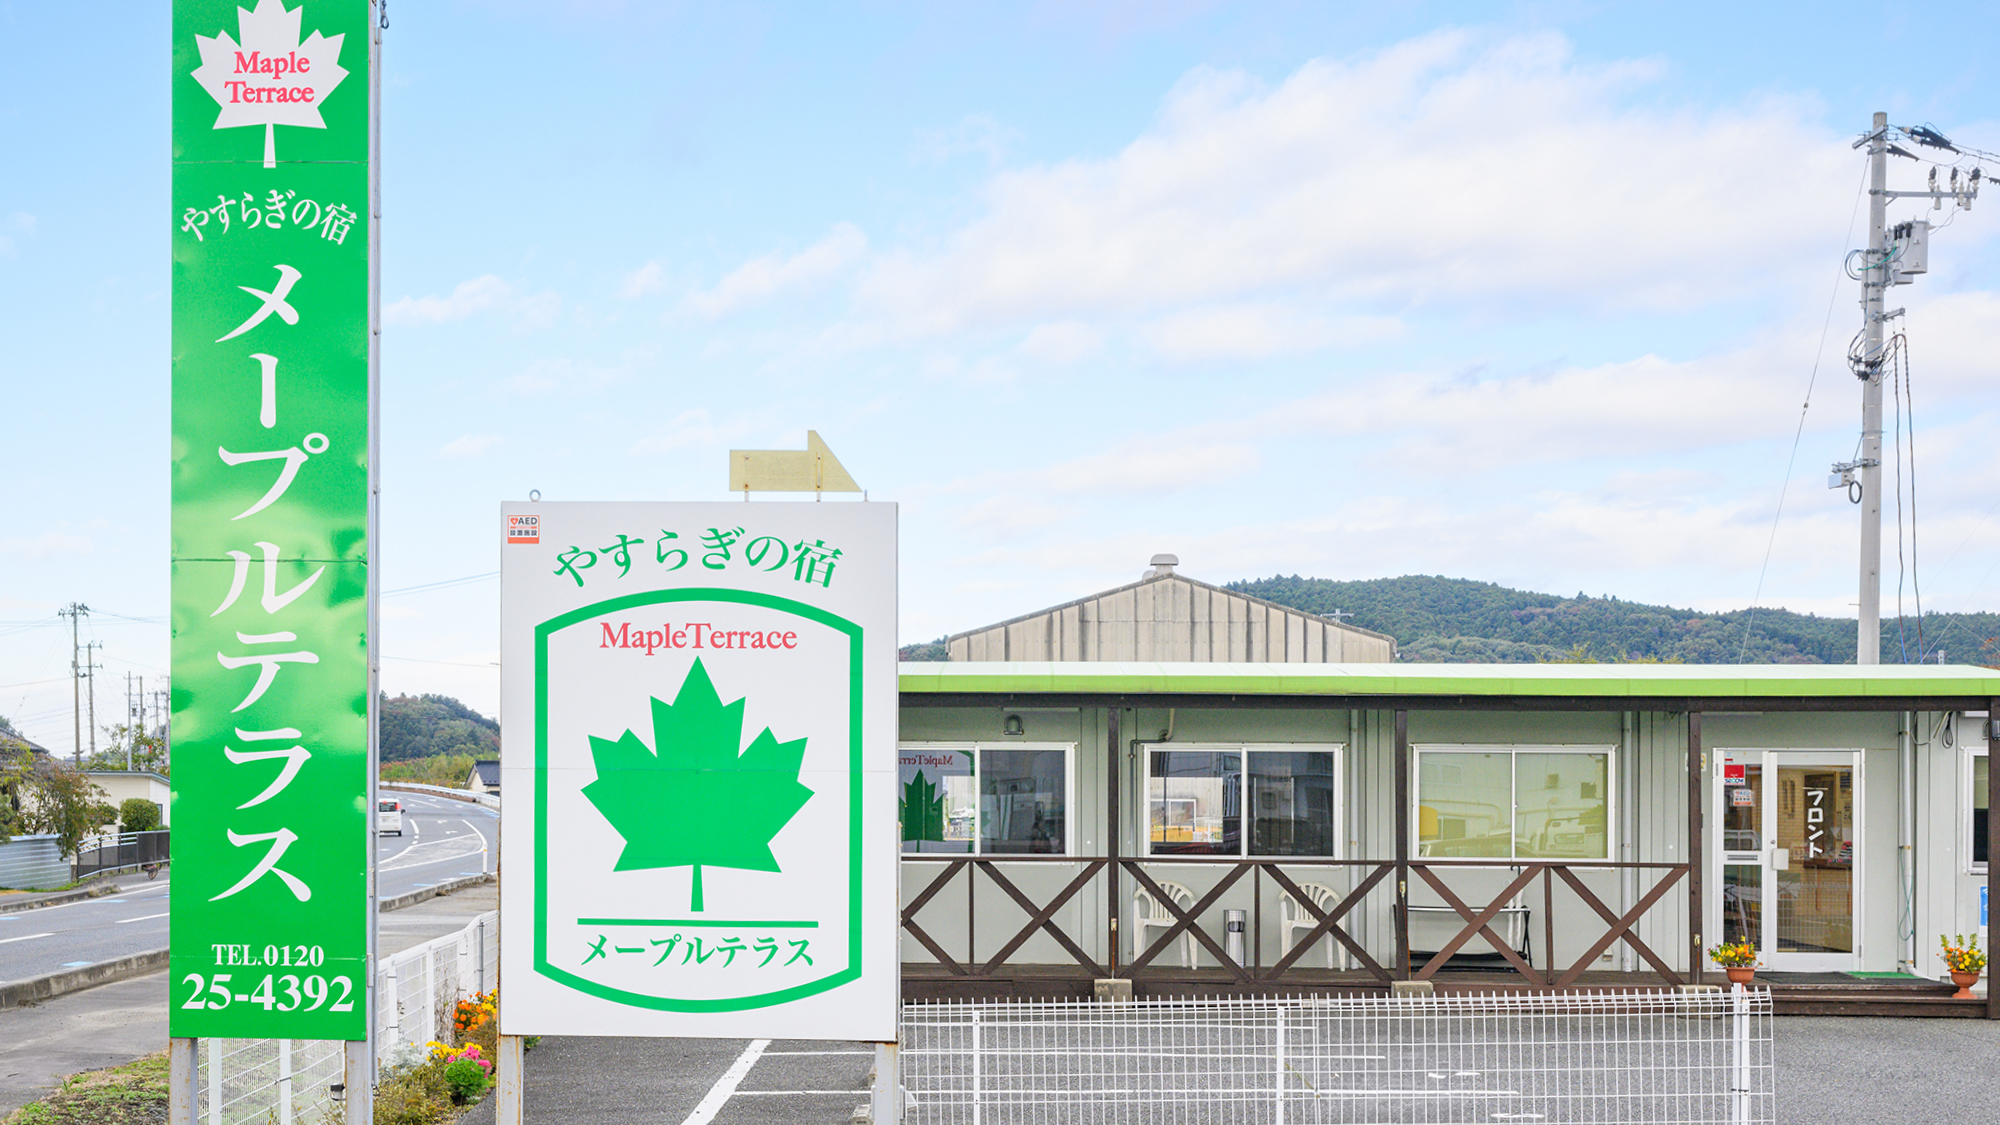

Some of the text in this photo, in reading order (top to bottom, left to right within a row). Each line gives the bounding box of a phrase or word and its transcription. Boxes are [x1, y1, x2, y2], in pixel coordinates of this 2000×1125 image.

[233, 51, 310, 79] Maple
[224, 81, 314, 103] Terrace
[181, 189, 357, 245] やすらぎの宿
[518, 517, 538, 525] AED
[552, 526, 844, 588] やすらぎの宿
[208, 264, 329, 902] メープルテラス
[1807, 790, 1824, 858] フロント
[581, 934, 814, 968] メープルテラス
[180, 973, 355, 1012] 25-4392
